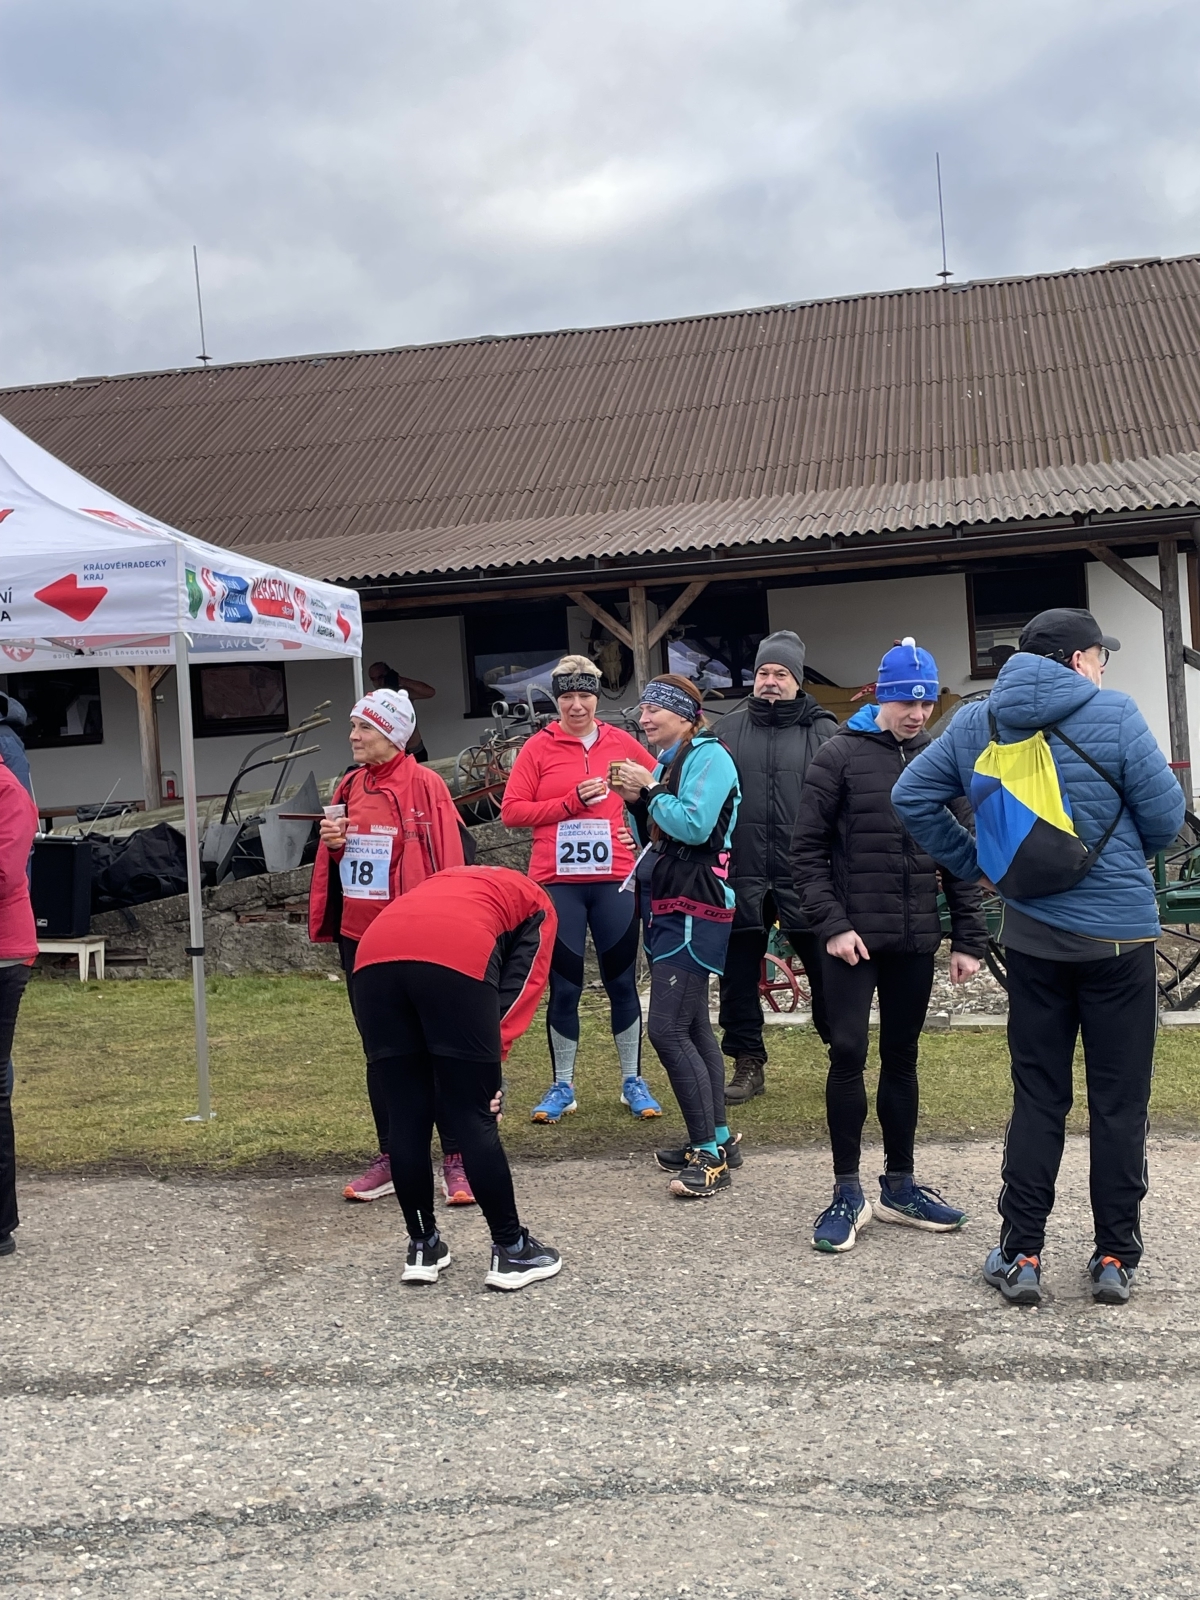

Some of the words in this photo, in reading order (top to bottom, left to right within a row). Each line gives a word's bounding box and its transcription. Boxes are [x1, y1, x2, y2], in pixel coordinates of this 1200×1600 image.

[83, 559, 167, 571] KRÁLOVÉHRADECKÝ
[83, 573, 104, 581] KRAJ
[364, 706, 395, 731] MARATON
[560, 841, 609, 863] 250
[350, 860, 374, 886] 18
